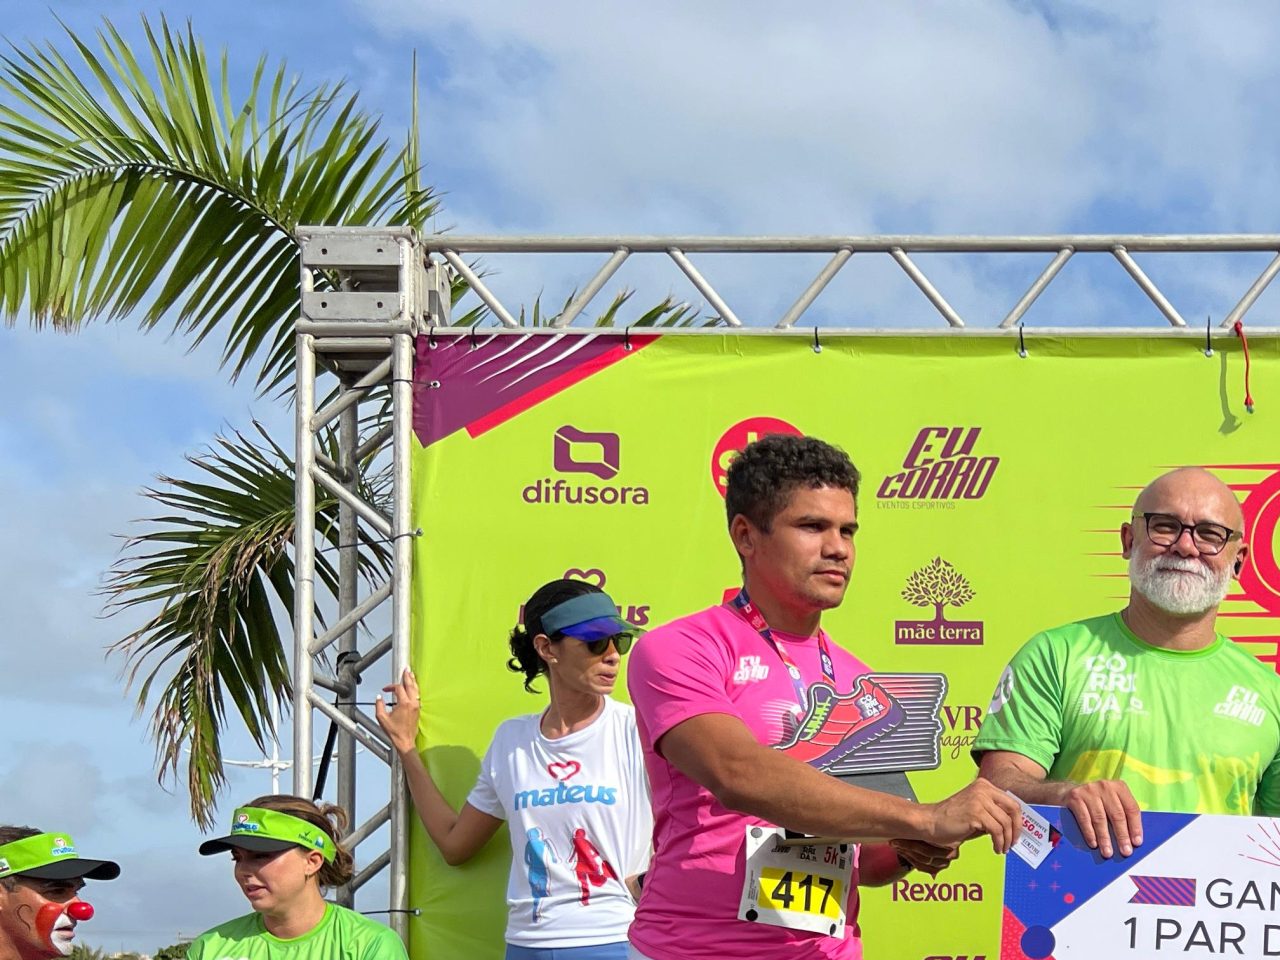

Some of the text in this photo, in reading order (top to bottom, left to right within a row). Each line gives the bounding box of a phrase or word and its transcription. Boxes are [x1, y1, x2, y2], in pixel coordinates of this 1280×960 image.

[903, 427, 982, 469] EU
[522, 478, 649, 504] difusora
[876, 456, 1000, 500] CORRO
[876, 500, 956, 510] EVENTOS ESPORTIVOS
[898, 623, 981, 641] mãe terra
[1083, 692, 1122, 715] DA
[514, 781, 618, 811] mateus
[771, 871, 834, 914] 417
[892, 879, 982, 901] Rexona
[1124, 917, 1137, 949] 1
[1155, 918, 1245, 956] PAR
